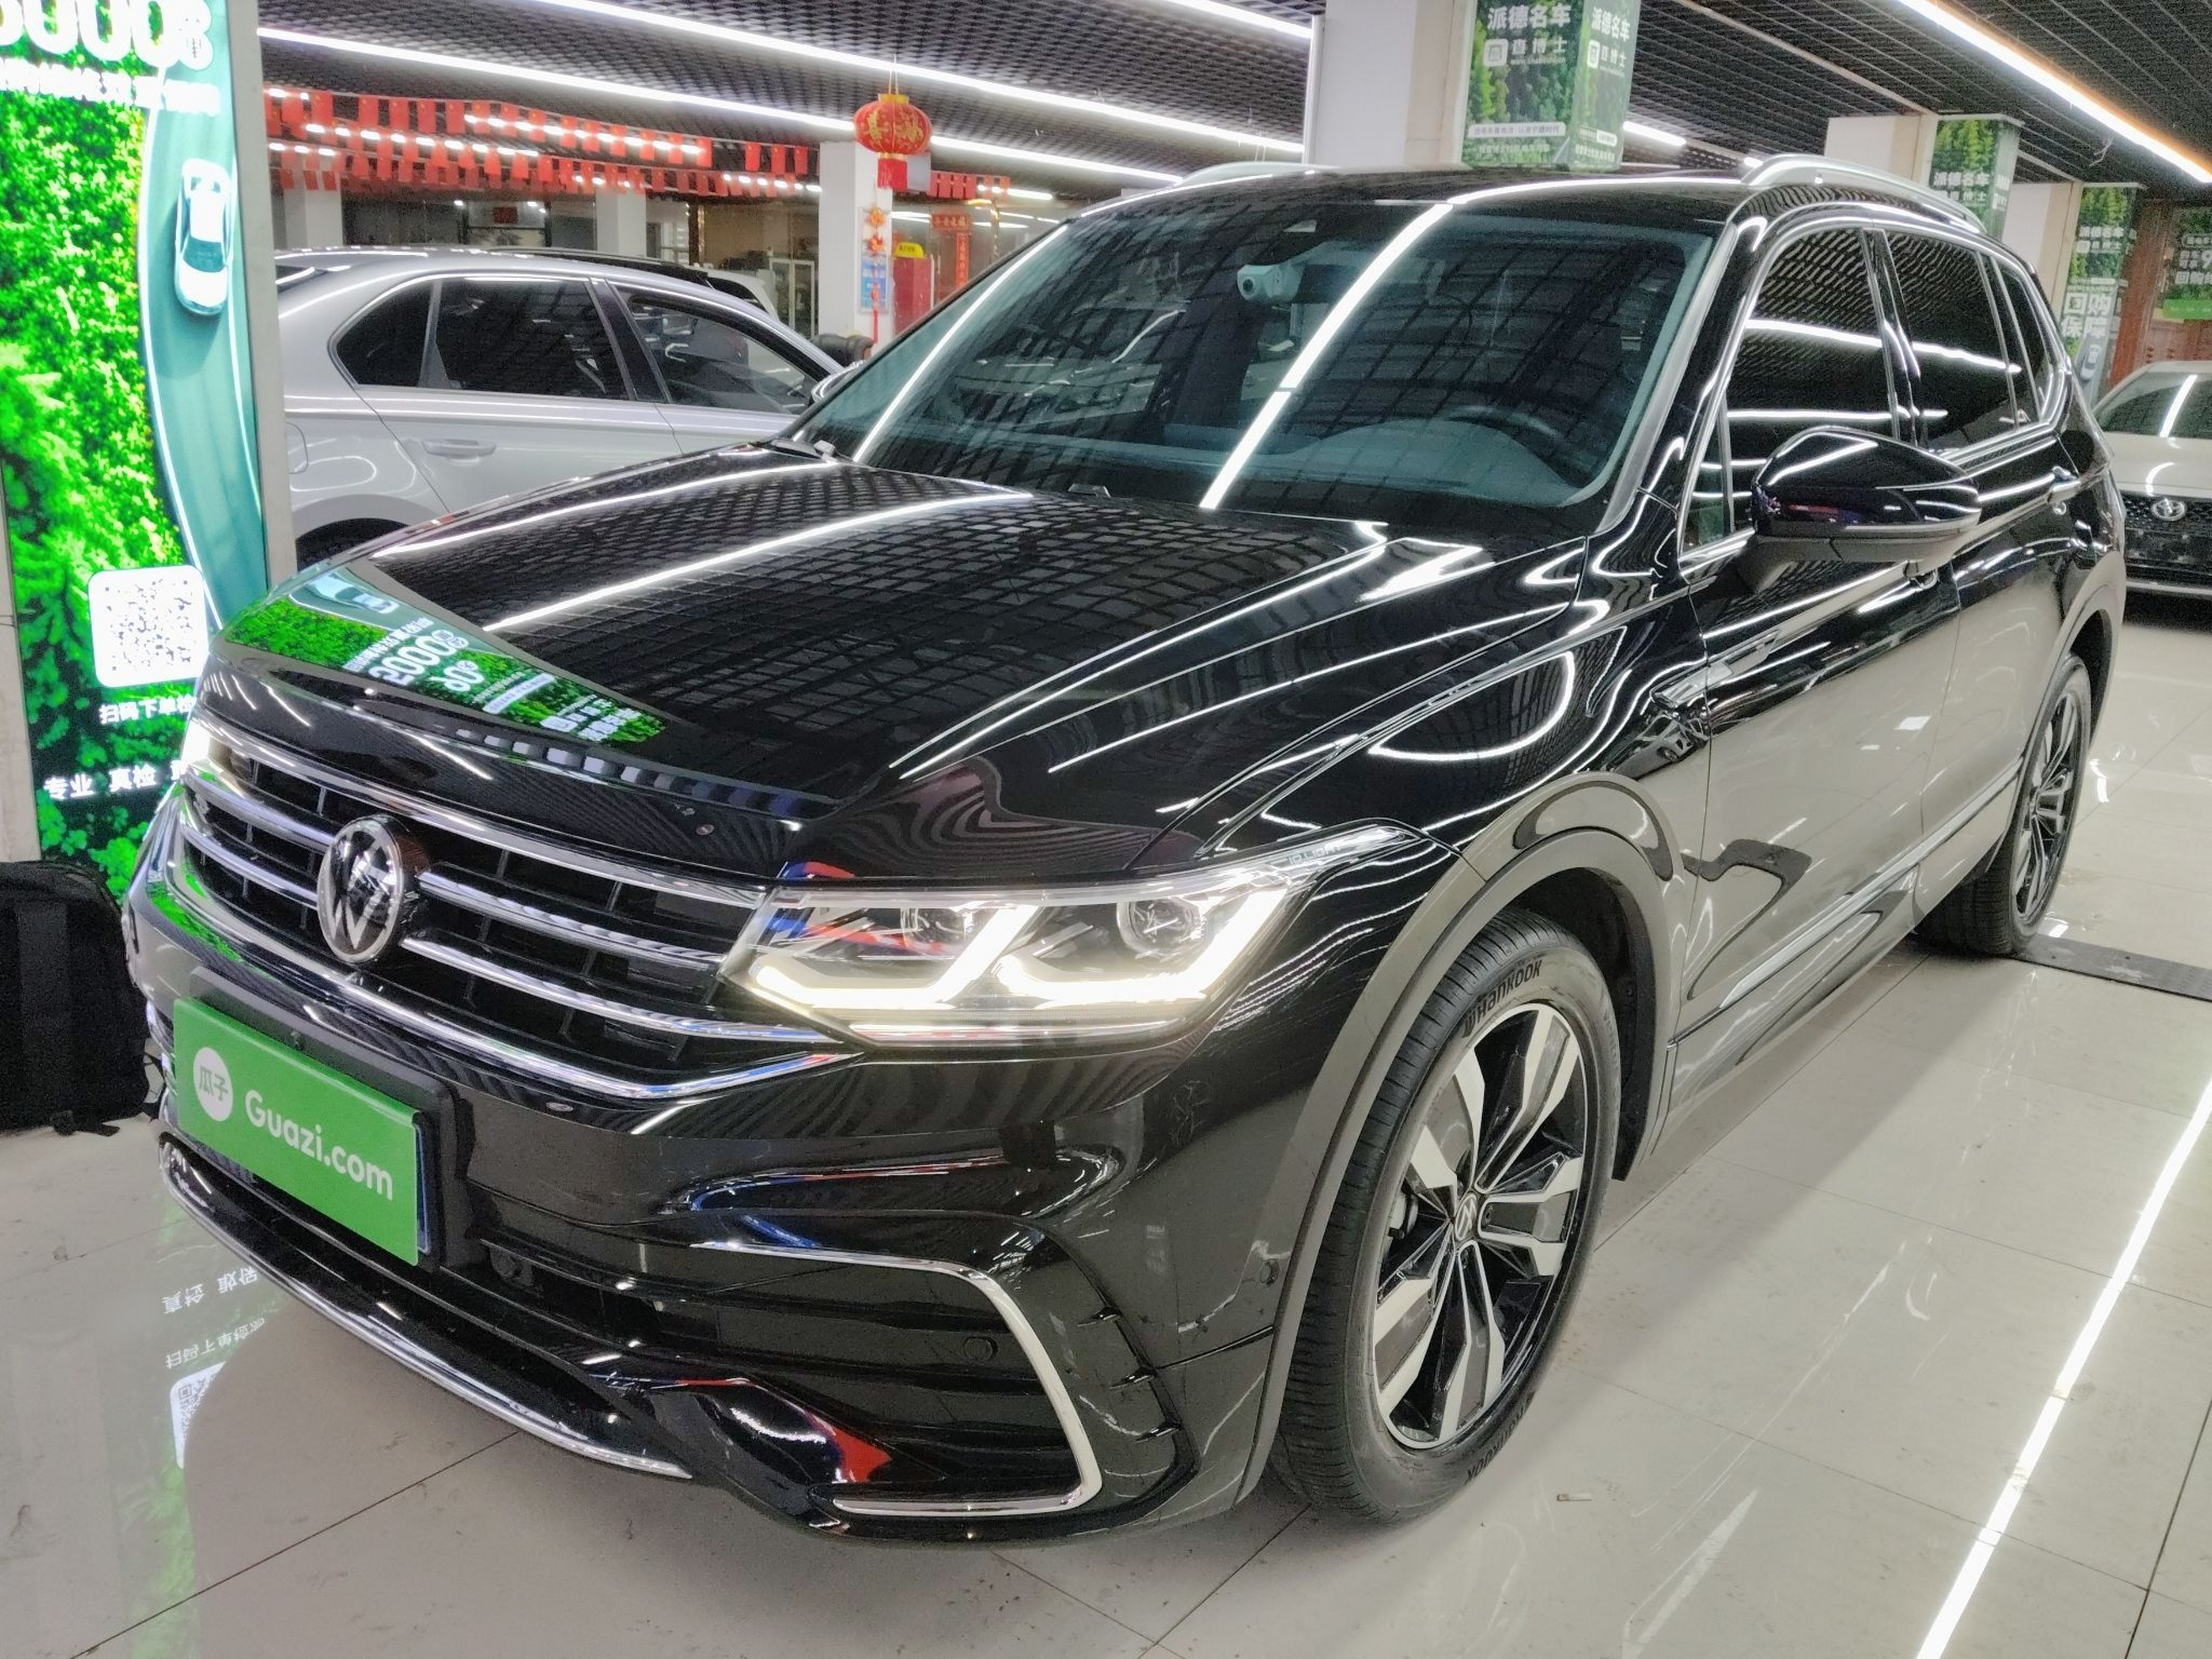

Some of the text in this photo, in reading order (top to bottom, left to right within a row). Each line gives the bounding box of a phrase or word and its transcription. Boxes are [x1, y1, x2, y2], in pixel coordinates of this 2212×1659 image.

[43, 773, 96, 800] 专业
[108, 763, 157, 793] 真检
[199, 1065, 229, 1102] 瓜子
[245, 1090, 393, 1201] Guazi.com
